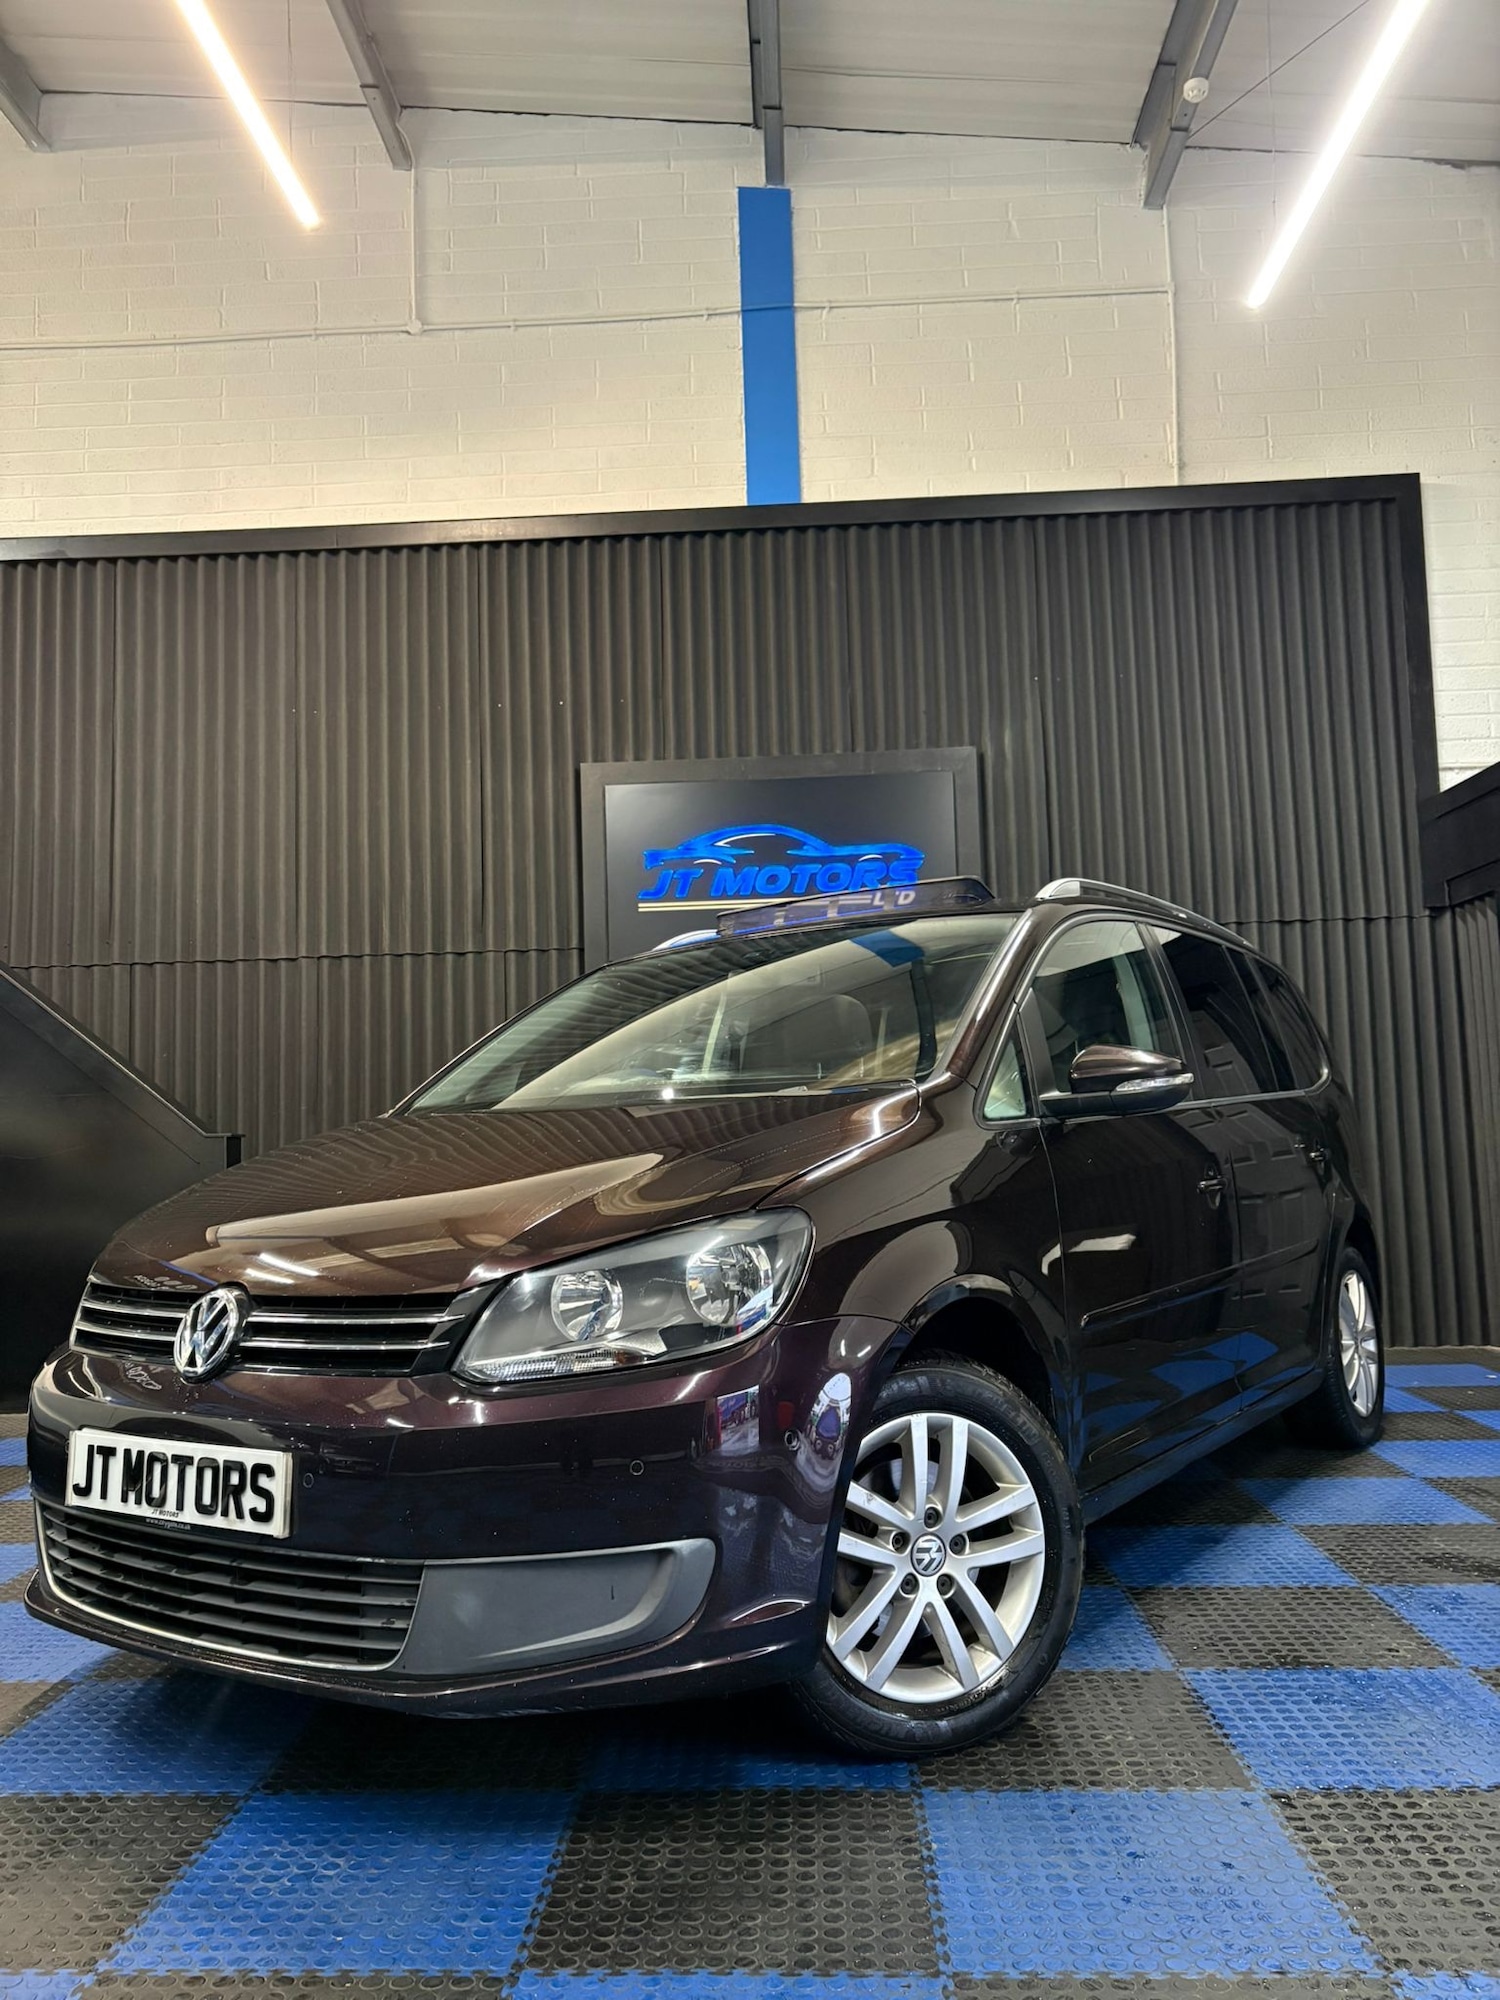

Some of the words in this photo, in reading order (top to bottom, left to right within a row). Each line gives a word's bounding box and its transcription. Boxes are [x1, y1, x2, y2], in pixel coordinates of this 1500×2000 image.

[637, 868, 704, 899] JT
[710, 860, 925, 896] MOTORS
[872, 889, 916, 907] LD
[72, 1444, 117, 1501] JT
[121, 1448, 276, 1523] MOTORS
[158, 1509, 180, 1519] MOTORS
